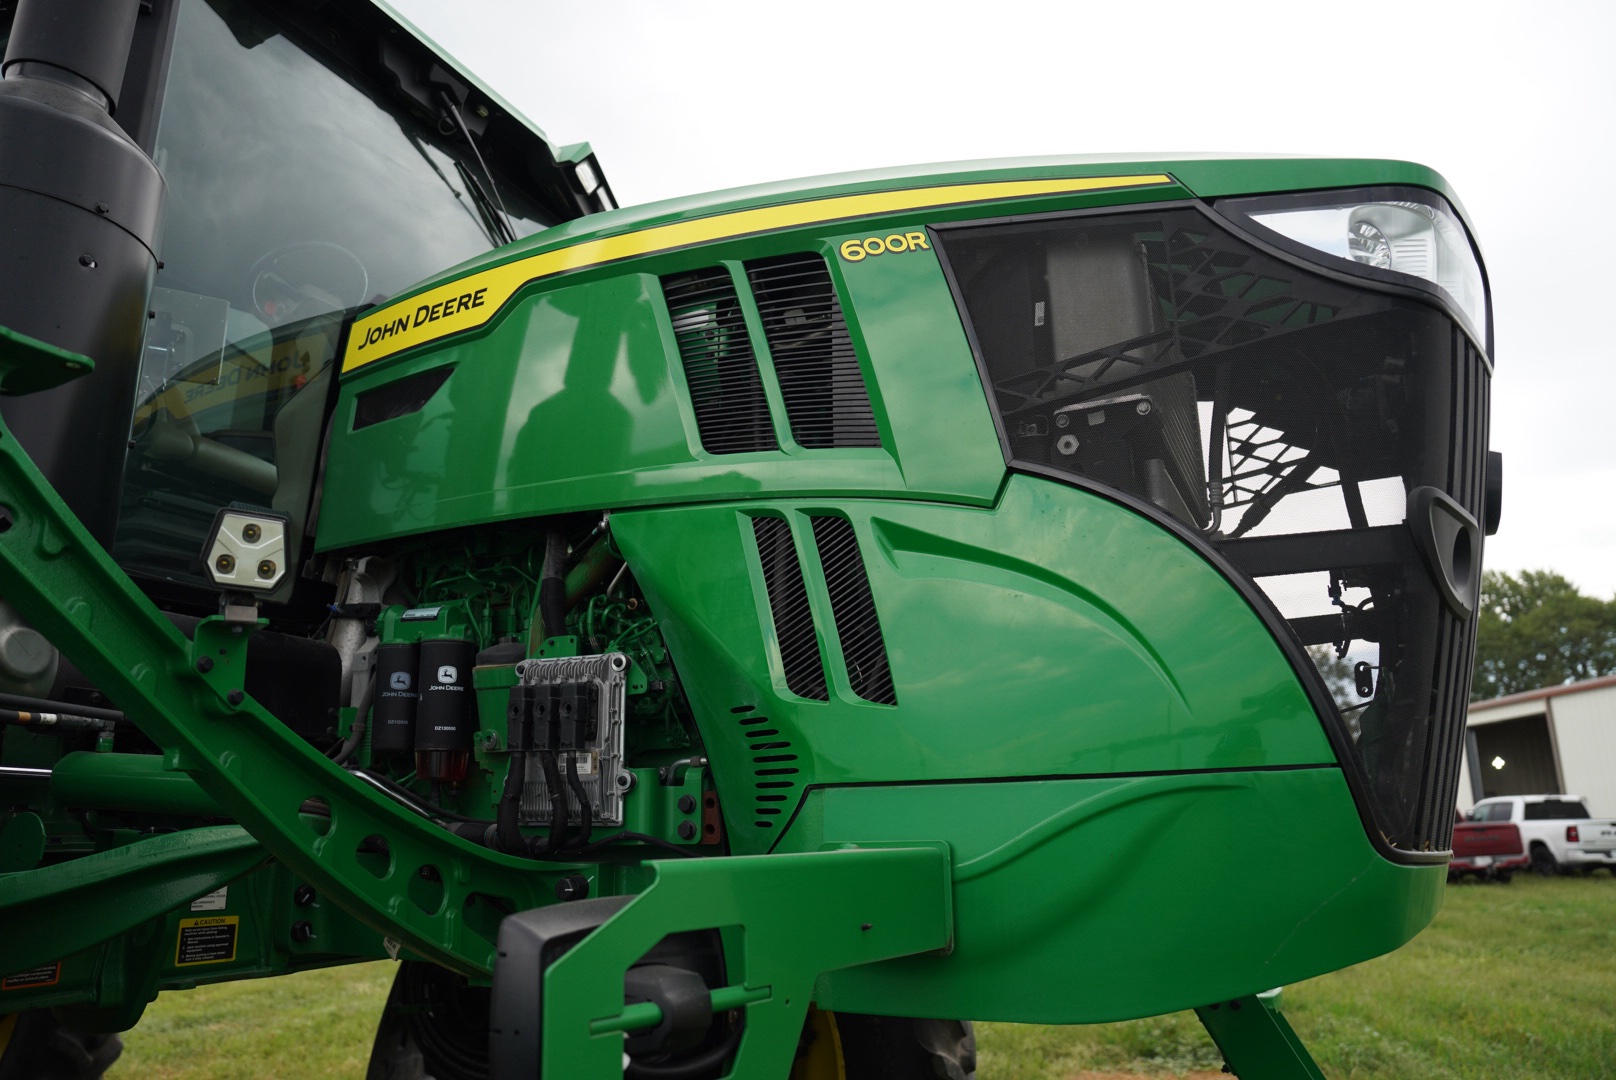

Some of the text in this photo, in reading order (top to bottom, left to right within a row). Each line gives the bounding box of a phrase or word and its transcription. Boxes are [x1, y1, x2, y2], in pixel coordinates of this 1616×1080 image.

[840, 232, 931, 262] 600R
[358, 288, 488, 350] JOHN DEERE
